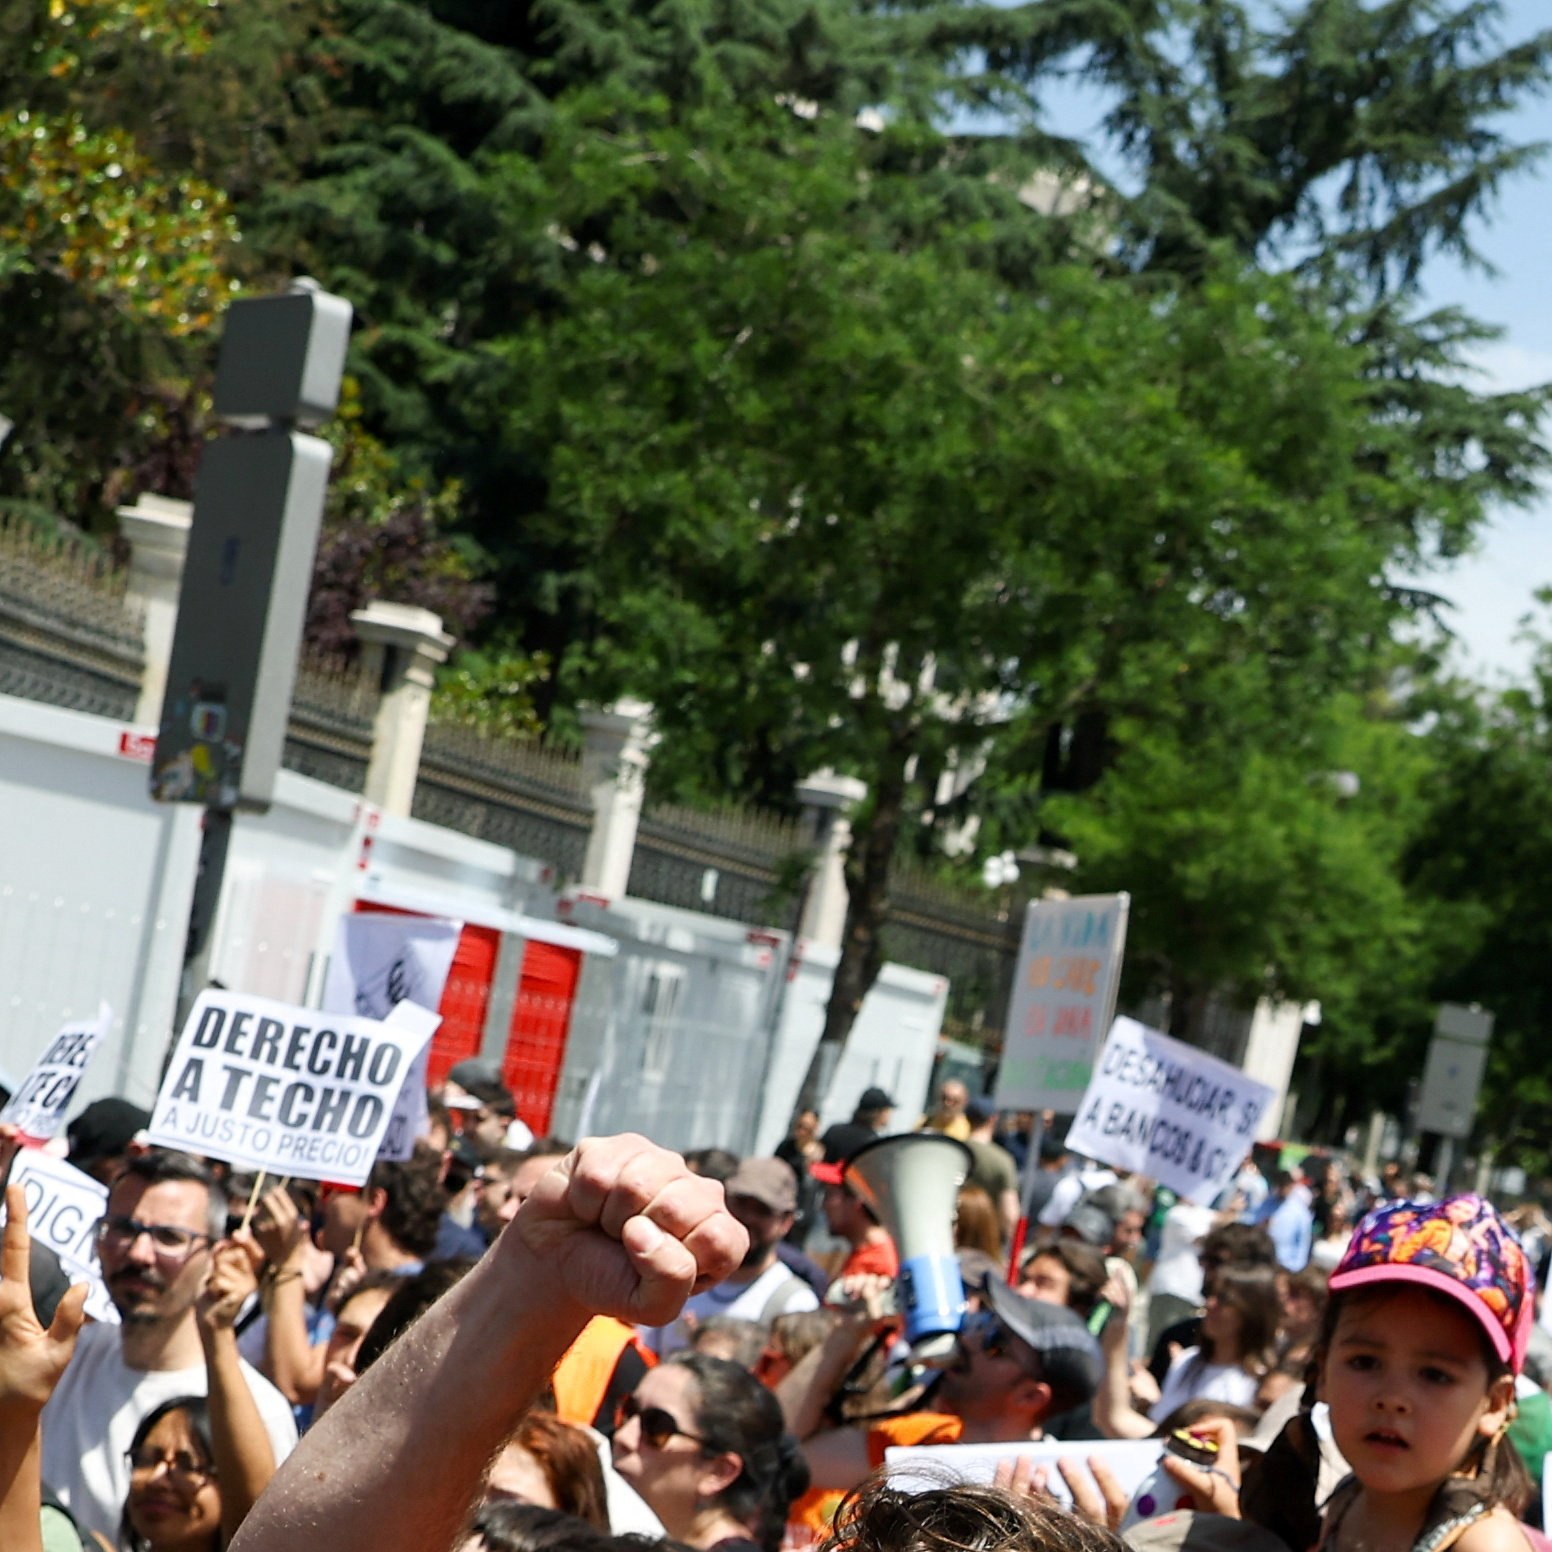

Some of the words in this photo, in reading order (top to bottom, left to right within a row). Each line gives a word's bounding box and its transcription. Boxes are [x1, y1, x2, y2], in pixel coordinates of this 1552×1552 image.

[192, 1006, 402, 1088] DERECHO
[160, 1106, 178, 1131] A
[186, 1110, 272, 1154] JUSTO
[276, 1131, 371, 1171] PRECIO!
[171, 1057, 205, 1103] A
[219, 1065, 384, 1140] TECHO
